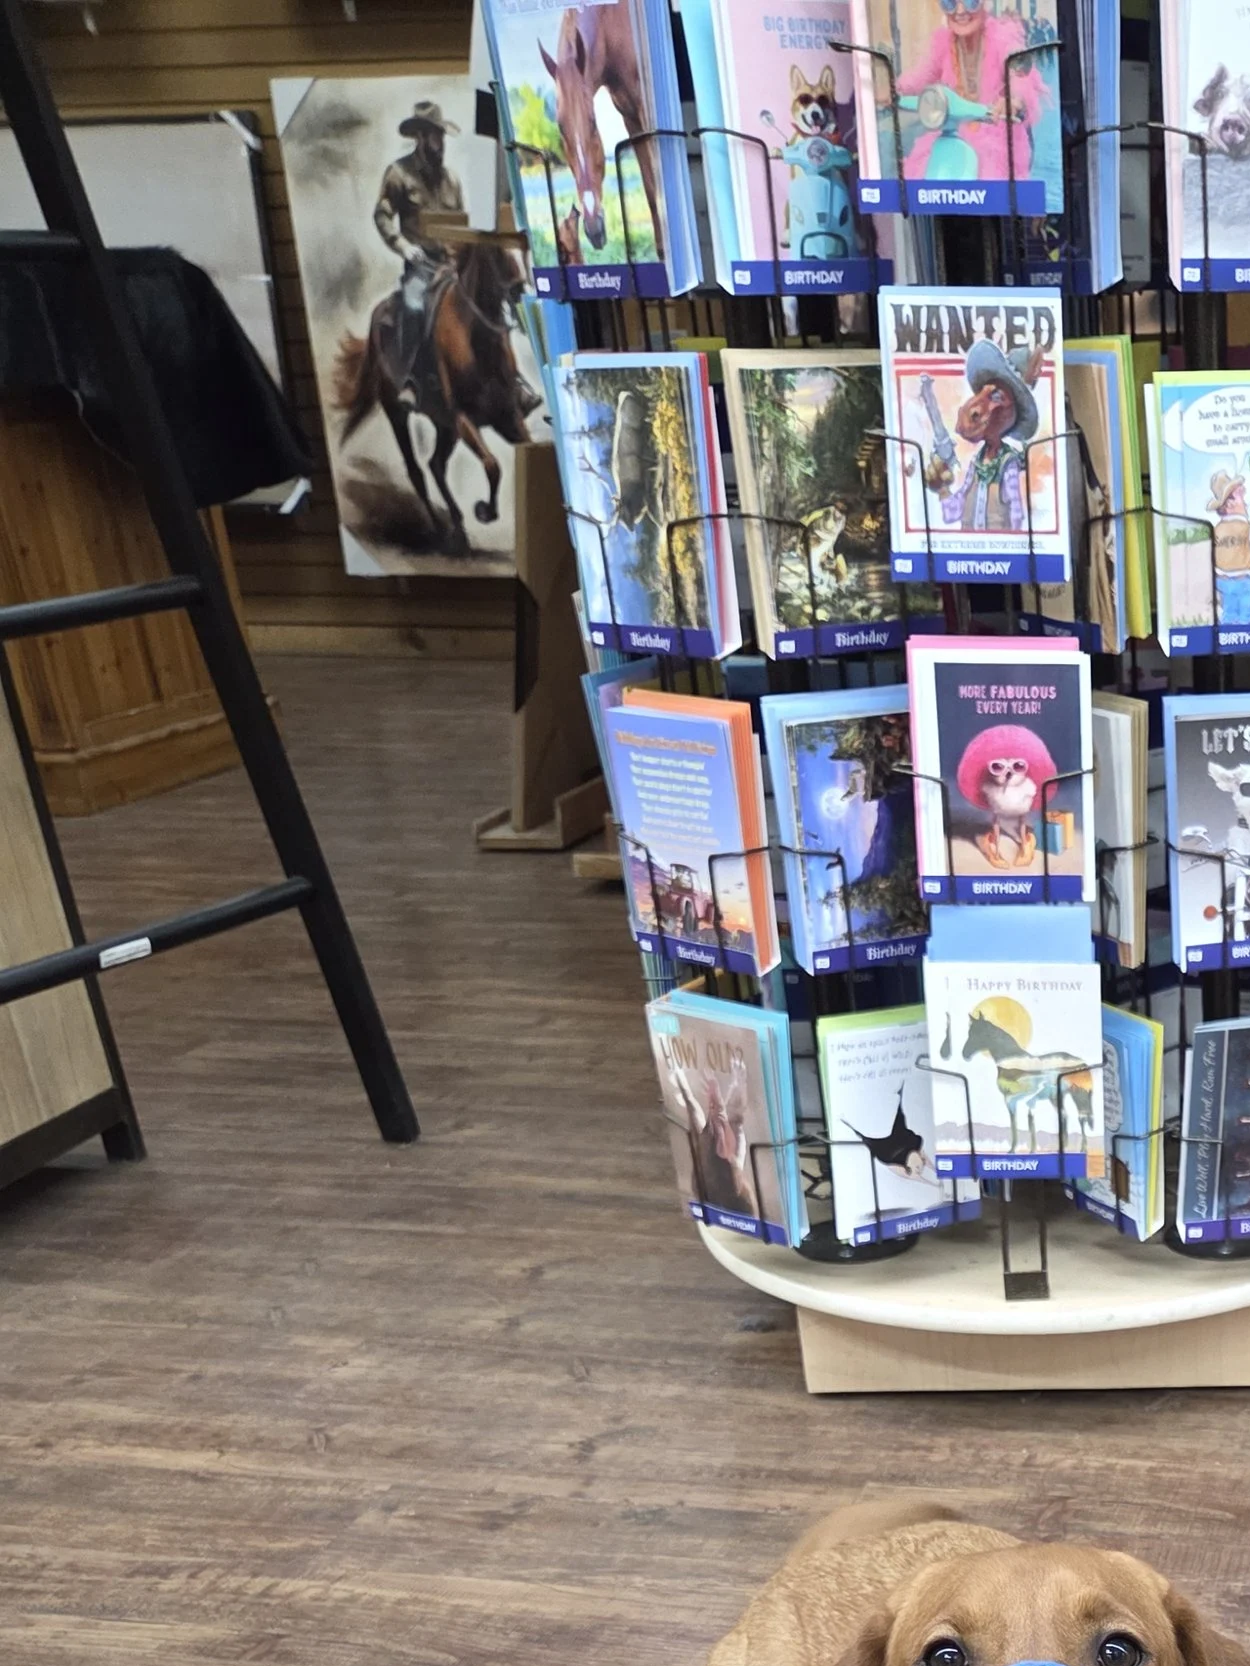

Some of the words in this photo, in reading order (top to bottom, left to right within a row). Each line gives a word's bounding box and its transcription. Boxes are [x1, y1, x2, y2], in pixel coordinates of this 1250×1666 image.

[763, 16, 784, 31] BIG
[787, 17, 845, 34] BIRTHDAY
[917, 188, 987, 205] BIRTHDAY
[784, 269, 844, 285] BIRTHDAY
[890, 304, 1057, 353] WANTED
[946, 560, 1012, 575] BIRTHDAY
[629, 631, 672, 651] Birthday
[834, 630, 891, 648] Birthday
[958, 684, 986, 699] MORE
[990, 685, 1057, 700] FABULOUS
[976, 700, 1008, 714] EVERY
[1011, 701, 1041, 715] YEAR!
[972, 882, 1033, 895] BIRTHDAY
[866, 944, 917, 960] Birthday
[967, 978, 1011, 992] HAPPY
[1017, 978, 1084, 992] BIRTHDAY
[1197, 1132, 1213, 1160] Ply
[982, 1160, 1039, 1172] BIRTHDAY
[896, 1217, 940, 1234] Birthday
